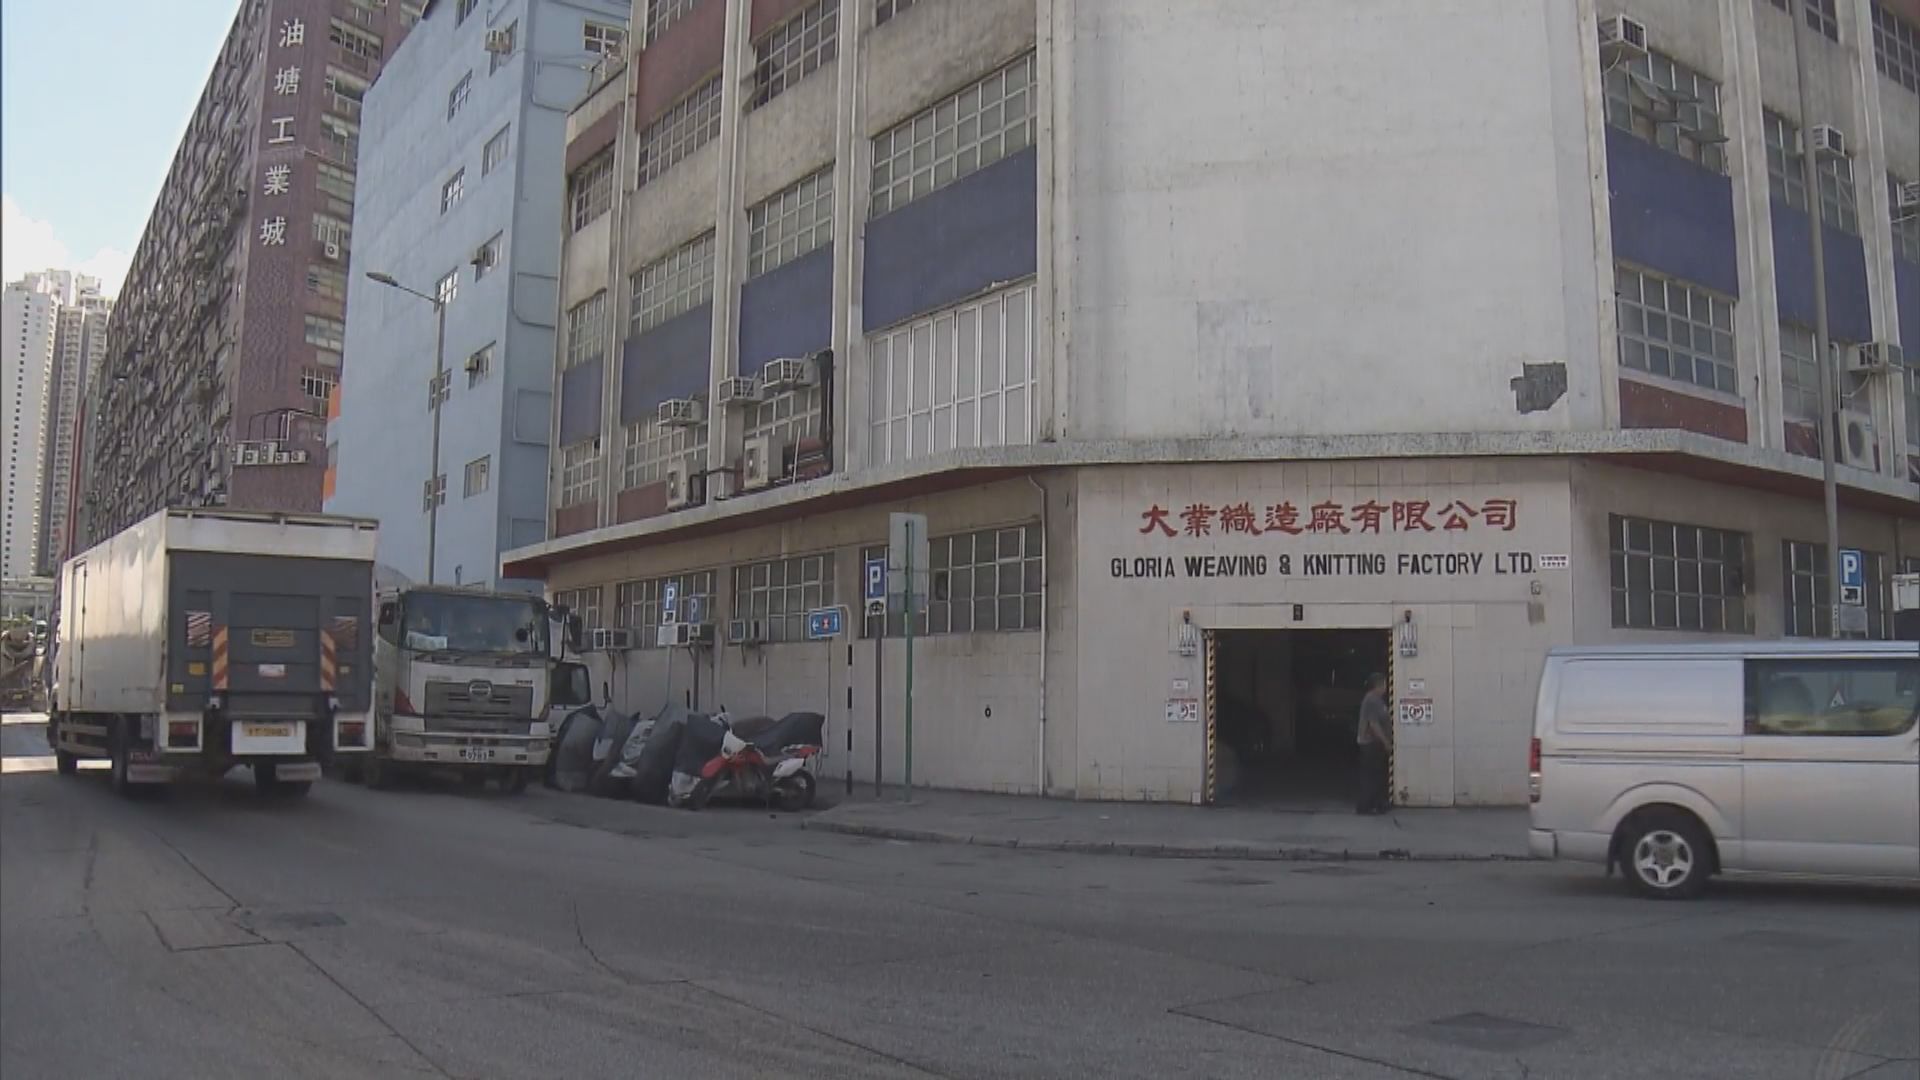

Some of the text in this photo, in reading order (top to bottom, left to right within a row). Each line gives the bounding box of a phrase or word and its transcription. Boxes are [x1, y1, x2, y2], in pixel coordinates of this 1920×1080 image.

[259, 17, 304, 247] 油塘工業城
[1140, 499, 1517, 537] 大業織造廠有限公司
[868, 565, 882, 594] P
[1110, 556, 1176, 579] GLORIA
[1184, 554, 1268, 578] WEAVING
[1279, 553, 1292, 576] &
[1303, 553, 1386, 576] KNITTING
[1398, 552, 1484, 576] FACTORY
[1494, 551, 1537, 575] LTD.
[1843, 553, 1858, 583] P
[666, 585, 676, 608] P
